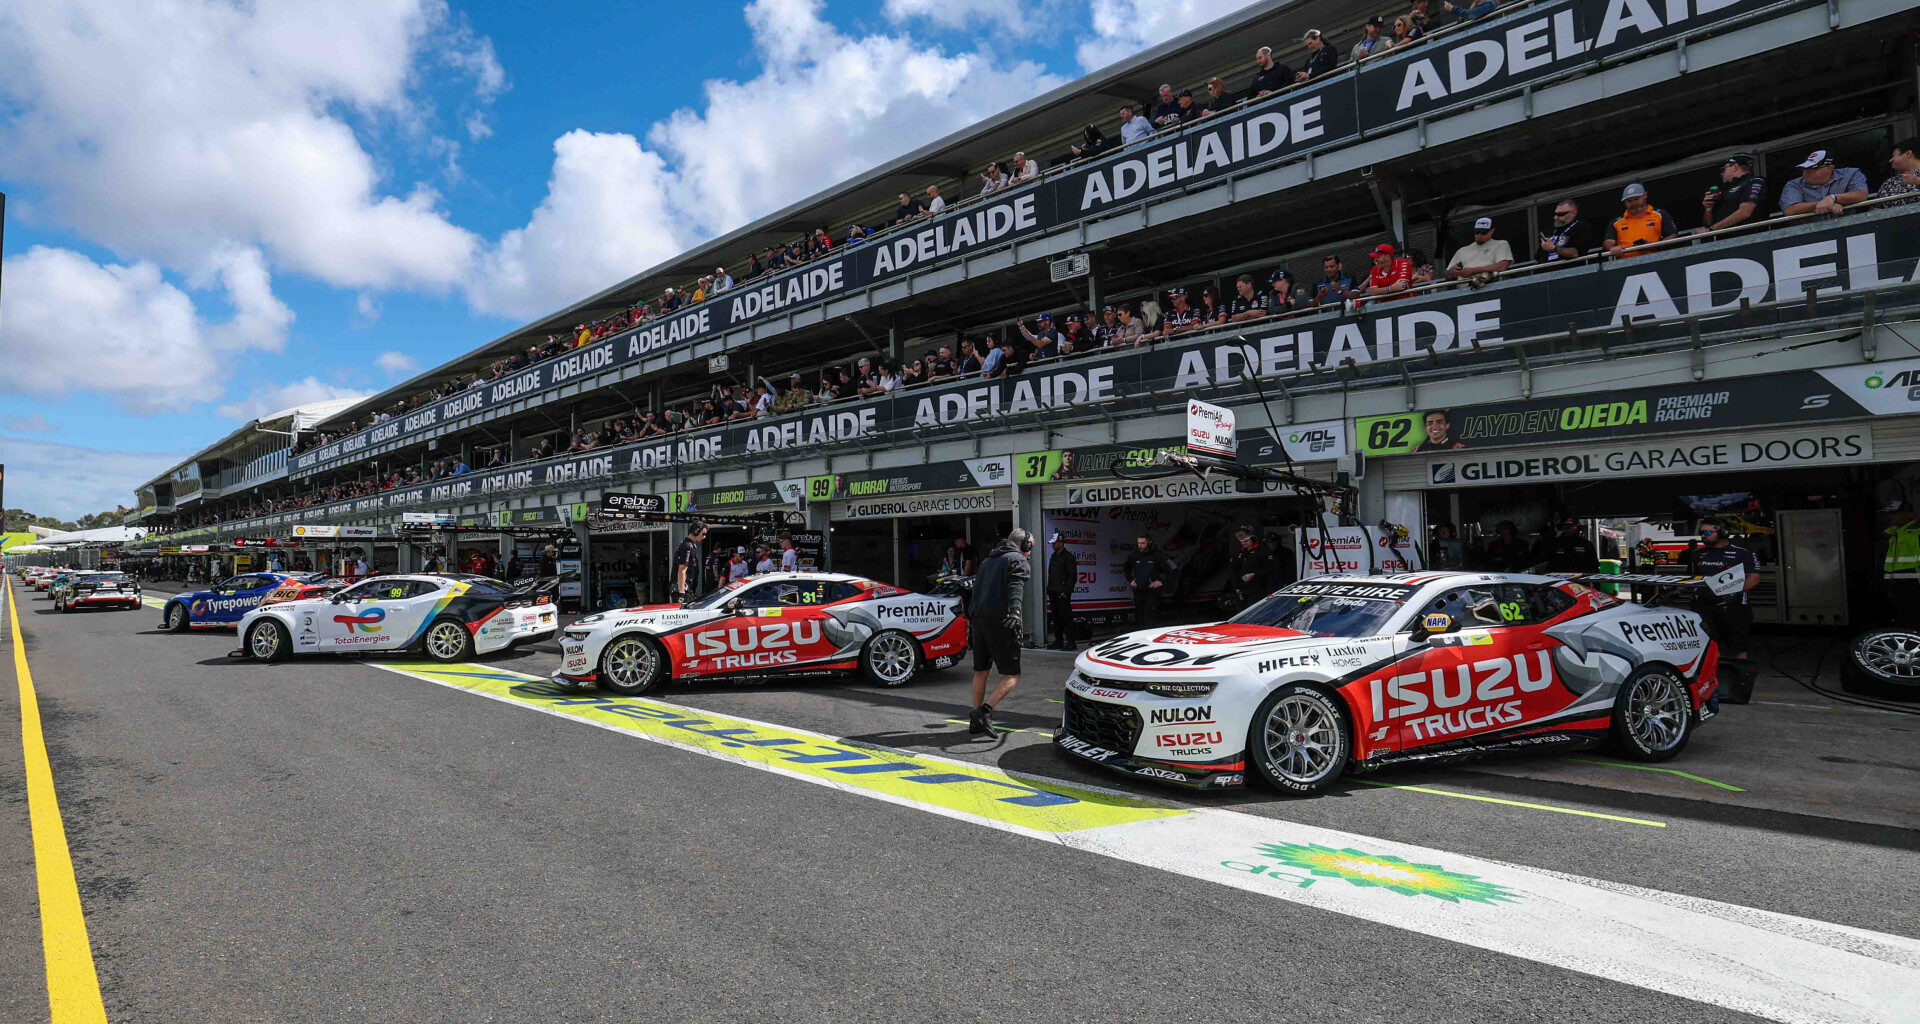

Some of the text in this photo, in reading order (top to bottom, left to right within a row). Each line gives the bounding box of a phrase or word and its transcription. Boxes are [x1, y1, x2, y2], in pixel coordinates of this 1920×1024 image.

[1081, 96, 1324, 211] ADELAIDE
[873, 193, 1037, 277] ADELAIDE
[1609, 233, 1920, 326] ADEL
[730, 261, 844, 324] ADELAIDE
[628, 308, 710, 358] ADELAIDE
[1173, 299, 1504, 390] ADELAIDE
[552, 344, 613, 384] ADELAIDE
[492, 369, 541, 403] ADELAIDE
[443, 391, 482, 419] ADELAIDE
[914, 366, 1116, 429] ADELAIDE
[1657, 391, 1730, 410] PREMIAIR
[404, 409, 436, 433] ADELAIDE
[1199, 406, 1223, 421] PremiAir
[1460, 400, 1648, 439] JAYDEN OJEDA
[1654, 405, 1713, 422] RACING
[371, 422, 398, 443] ADELAIDE
[746, 407, 877, 452] ADELAIDE
[1190, 428, 1210, 439] ISUZU
[1299, 429, 1336, 443] ADL
[1367, 418, 1412, 449] 62
[343, 434, 366, 453] ADELAIDE
[1215, 434, 1233, 446] NULON
[1310, 440, 1336, 453] GF
[630, 435, 722, 471] ADELAIDE
[1461, 435, 1862, 480] GLIDEROL GARAGE DOORS
[545, 455, 613, 484] ADELAIDE
[982, 462, 1005, 472] ADL
[989, 470, 1005, 480] GF
[1026, 454, 1048, 478] 31
[481, 469, 533, 494] ADELAIDE
[812, 479, 830, 497] 99
[849, 479, 889, 495] MURRAY
[1086, 485, 1164, 503] GLIDEROL
[1166, 479, 1232, 497] GARAGE
[609, 495, 659, 507] erebus
[858, 495, 992, 517] GLIDEROL GARAGE DOORS
[576, 505, 581, 517] 4
[1309, 561, 1358, 570] ISUZU
[391, 588, 402, 598] 99
[802, 592, 816, 603] 31
[1345, 586, 1410, 599] HIRE
[207, 594, 262, 613] Tyrepower
[877, 602, 946, 619] PremiAir
[1333, 598, 1368, 607] Ojeda
[1499, 602, 1524, 621] 62
[615, 617, 656, 628] HIFLEX
[1426, 617, 1448, 628] NAPA
[1618, 614, 1698, 645] PremiAir
[334, 634, 391, 646] TotalEnergies
[685, 620, 821, 657] ISUZU
[1664, 640, 1700, 652] 1300 WE HIRE
[712, 649, 797, 669] TRUCKS
[1325, 645, 1367, 657] Luxton
[567, 657, 587, 669] ISUZU
[1258, 653, 1320, 673] HIFLEX
[1331, 658, 1362, 668] HOMES
[1091, 688, 1128, 699] ISUZU
[1370, 650, 1552, 722] ISUZU
[1670, 671, 1693, 716] DUNLOP
[1295, 687, 1341, 720] SPORT MAXX
[1150, 705, 1212, 724] NULON
[1405, 700, 1522, 740] TRUCKS
[1059, 733, 1118, 761] HIFLEX
[1156, 731, 1222, 747] ISUZU
[1169, 747, 1212, 756] TRUCKS
[1264, 761, 1309, 793] DUNLOP
